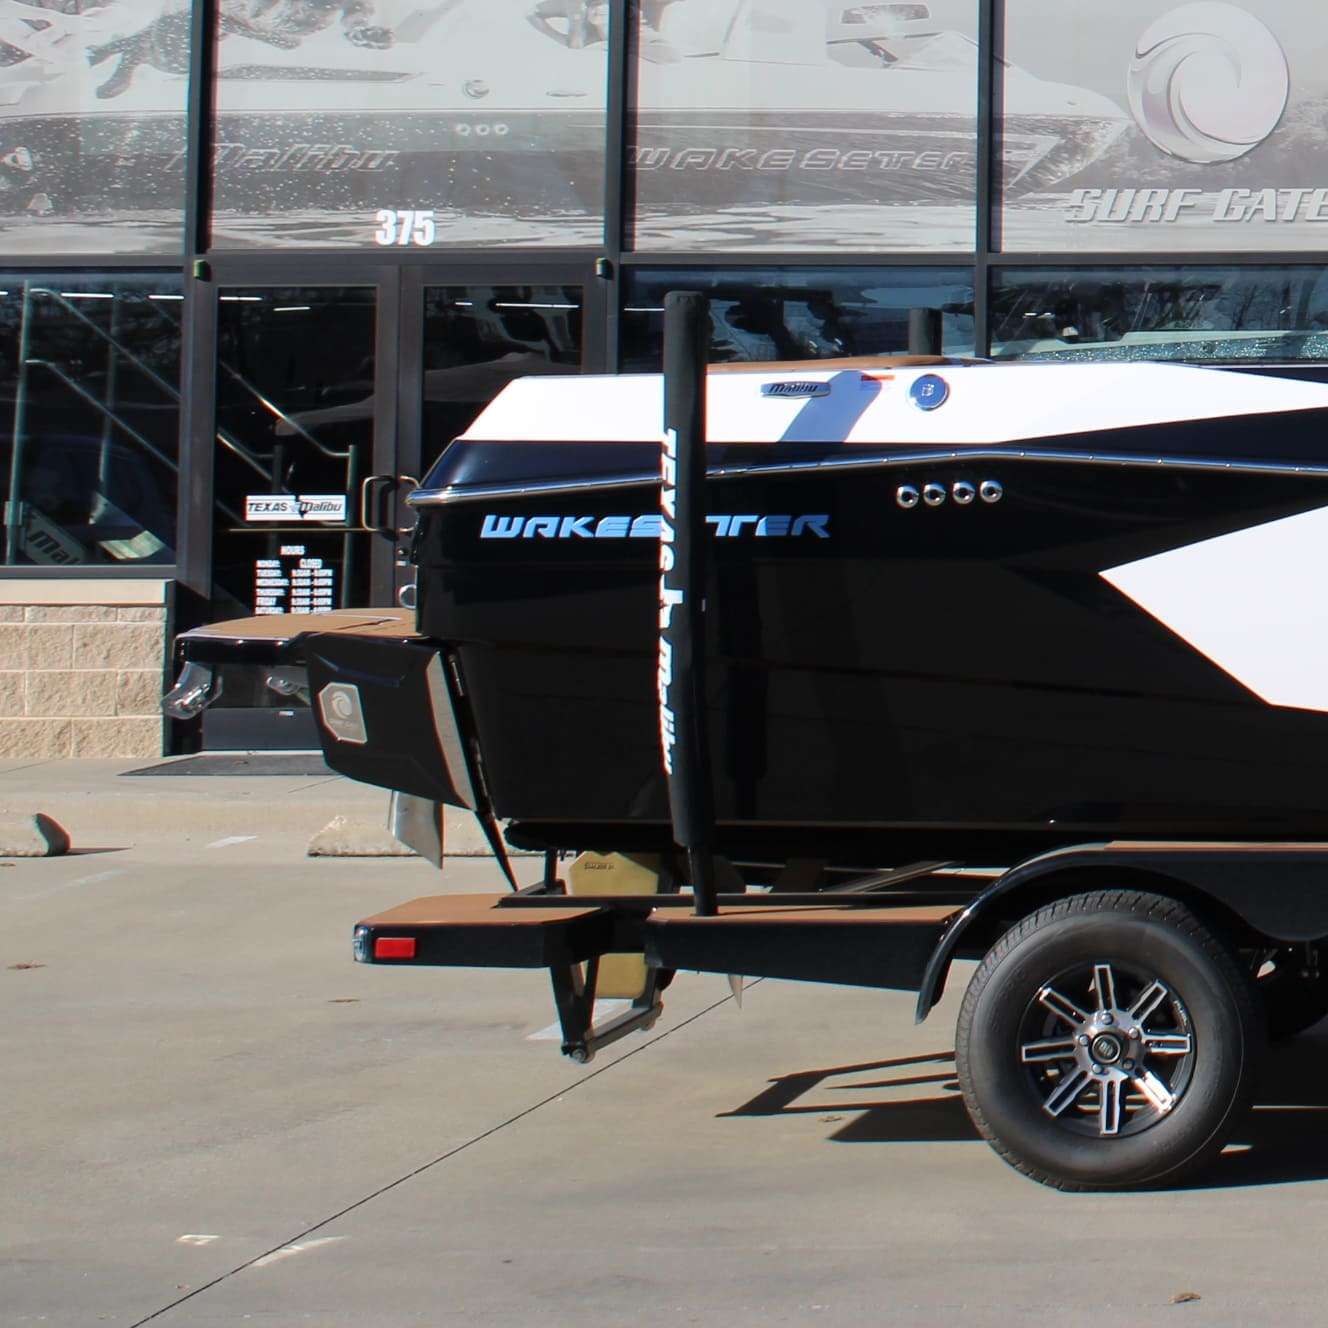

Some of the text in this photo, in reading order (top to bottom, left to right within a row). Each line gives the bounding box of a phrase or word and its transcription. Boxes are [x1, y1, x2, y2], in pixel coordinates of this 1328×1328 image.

[1065, 188, 1202, 222] SURF
[375, 210, 435, 246] 375
[769, 383, 818, 393] Malibu
[248, 501, 342, 512] TEXAS Malibu
[480, 514, 831, 539] WAKESTTER
